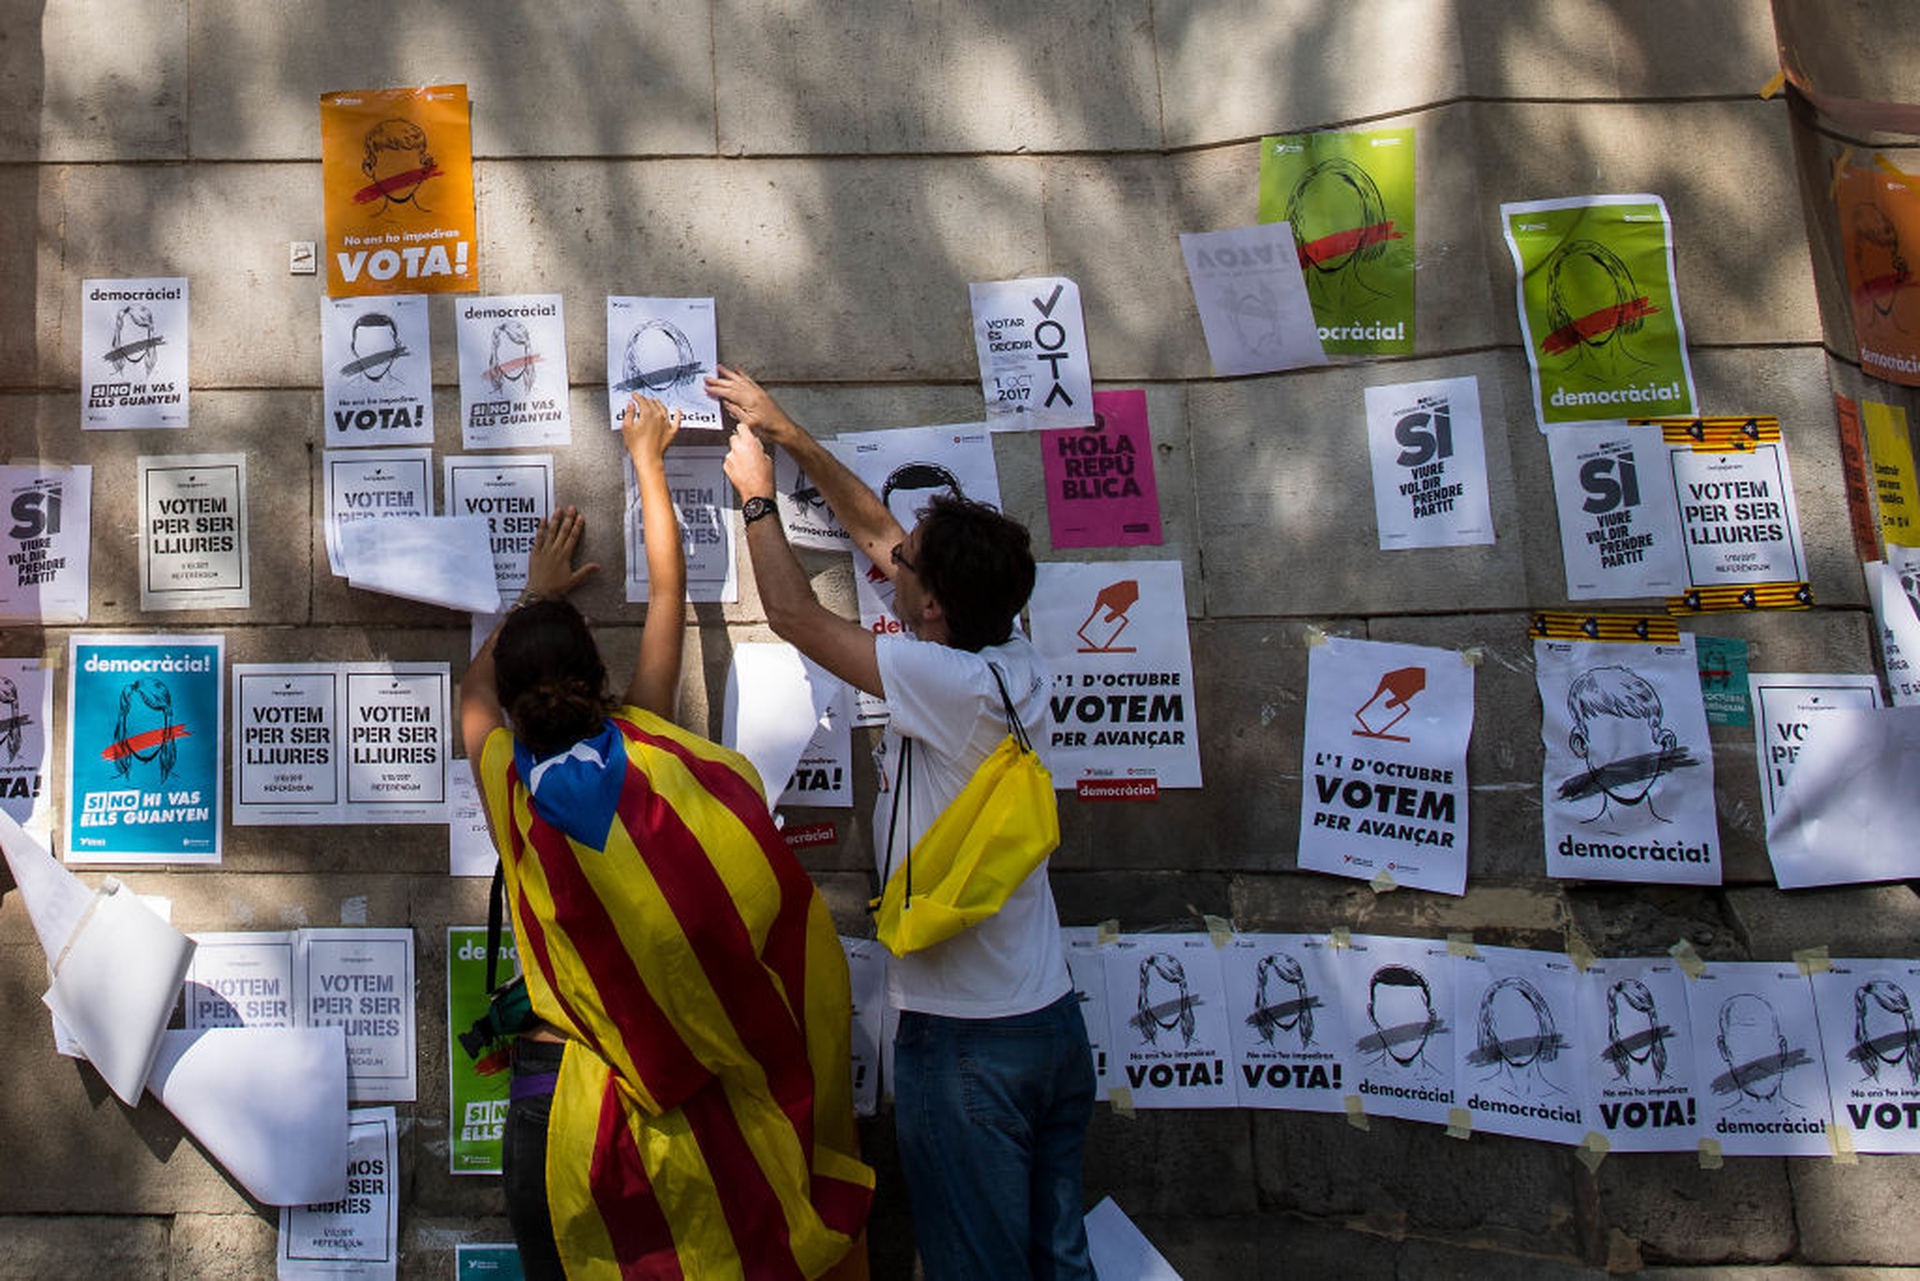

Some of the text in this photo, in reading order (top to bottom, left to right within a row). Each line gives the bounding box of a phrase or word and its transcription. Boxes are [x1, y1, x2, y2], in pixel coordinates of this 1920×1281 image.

[345, 236, 361, 245] No
[386, 233, 399, 243] ho
[337, 242, 468, 282] VOTA!
[90, 288, 181, 300] democràcia!
[465, 304, 556, 319] democràcia!
[986, 319, 1025, 329] VOTAR
[1318, 322, 1404, 340] ocràcia!
[989, 341, 1033, 352] DECIDIR
[110, 385, 129, 395] NO
[133, 385, 146, 394] HI
[153, 382, 174, 392] VAS
[994, 378, 1001, 388] 1
[88, 394, 180, 408] ELLS GUANYEN
[997, 388, 1031, 400] 2017
[1551, 382, 1680, 407] democràcia!
[490, 403, 509, 414] NO
[513, 402, 527, 411] HI
[532, 400, 554, 410] VAS
[335, 405, 424, 432] VOTA!
[469, 411, 561, 427] ELLS GUANYEN
[1058, 435, 1136, 457] HOLA
[1411, 461, 1444, 480] VIURE
[673, 487, 713, 502] TEM
[1063, 477, 1141, 499] BLICA
[1400, 477, 1440, 496] VOL DIR
[1412, 483, 1463, 506] PRENDRE
[1689, 481, 1769, 500] VOTEM
[159, 498, 226, 515] VOTEM
[345, 491, 414, 508] VOTEM
[465, 497, 535, 514] VOTEM
[1414, 499, 1454, 518] PARTIT
[683, 509, 721, 525] SER
[1597, 510, 1632, 528] VIURE
[1685, 503, 1780, 523] PER SER
[153, 517, 235, 535] PER SER
[503, 517, 541, 533] SER
[1586, 525, 1628, 544] VOL DIR
[1691, 525, 1784, 545] LLIURES
[20, 537, 51, 551] VIURE
[154, 536, 234, 554] LLIURES
[490, 537, 535, 554] URES
[1600, 534, 1653, 555] PRENDRE
[8, 549, 47, 566] VOL DIR
[18, 558, 66, 575] PRENDRE
[1601, 550, 1645, 569] PARTIT
[18, 570, 57, 587] PARTIT
[84, 654, 211, 673] democràcia!
[1083, 673, 1180, 687] D'OCTUBRE
[253, 706, 323, 723] VOTEM
[360, 706, 430, 722] VOTEM
[1050, 695, 1183, 723] VOTEM
[245, 727, 330, 744] PER SER
[353, 726, 437, 743] PER SER
[1051, 731, 1185, 749] PER AVANÇAR
[247, 748, 329, 765] LLIURES
[354, 747, 436, 764] LLIURES
[1316, 752, 1453, 784] L'1 D'OCTUBRE
[785, 768, 842, 791] TA!
[1080, 785, 1156, 796] democràcia!
[1315, 775, 1456, 823] VOTEM
[88, 791, 201, 809] SI NO HI VAS
[80, 808, 209, 827] ELLS GUANYEN
[1314, 812, 1455, 848] PER AVANÇAR
[1558, 834, 1710, 863] democràcia!
[207, 978, 279, 997] VOTEM
[320, 975, 393, 992] VOTEM
[200, 1001, 287, 1019] PER SER
[313, 997, 400, 1015] PER SER
[1126, 1060, 1223, 1089] VOTA!
[1243, 1064, 1342, 1090] VOTA!
[1359, 1079, 1455, 1104] democràcia!
[469, 1104, 509, 1122] SI N
[1468, 1095, 1582, 1124] democràcia!
[1600, 1098, 1697, 1130] VOTA!
[1846, 1102, 1920, 1130] VOT
[462, 1125, 503, 1141] ELLS
[1717, 1118, 1825, 1134] democràcia!
[349, 1179, 384, 1195] SER
